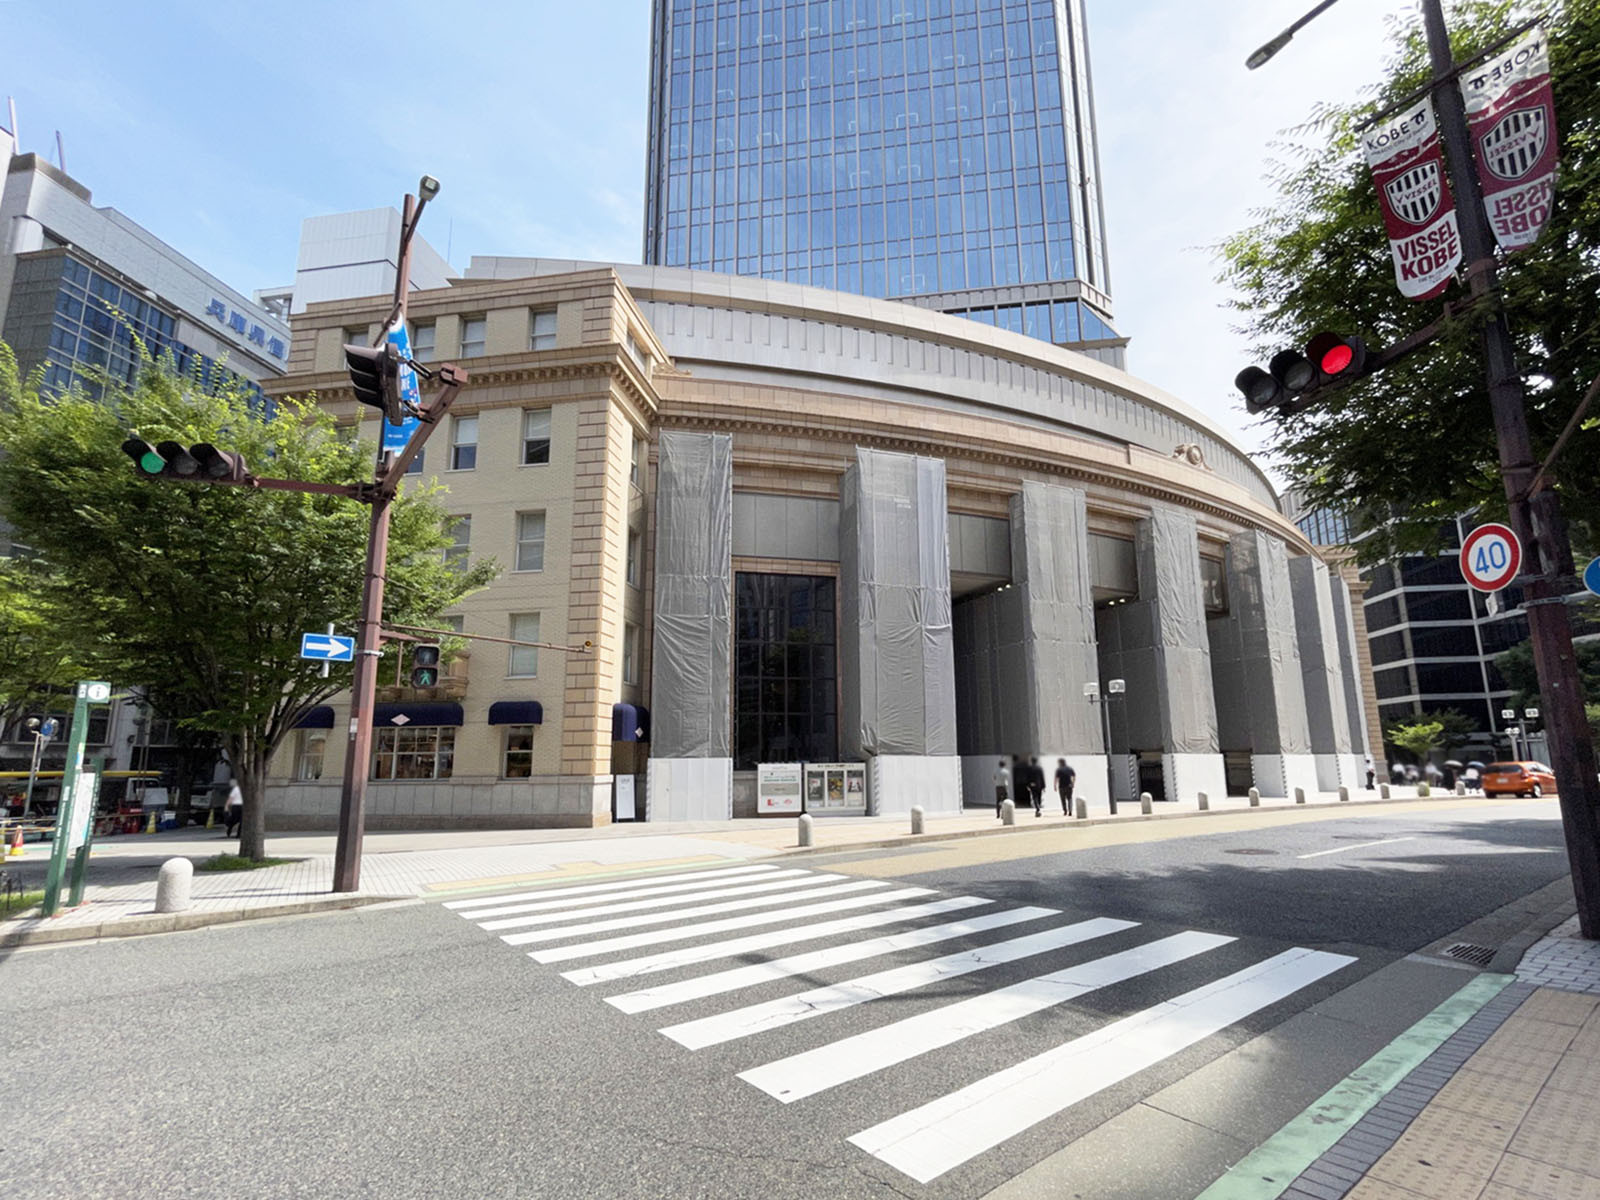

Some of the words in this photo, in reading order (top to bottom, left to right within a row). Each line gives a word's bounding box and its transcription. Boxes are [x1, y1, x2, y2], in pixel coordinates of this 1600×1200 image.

[1366, 121, 1410, 151] KOBE
[1397, 220, 1456, 262] VISSEL
[1401, 237, 1458, 281] KOBE
[1475, 541, 1506, 574] 40
